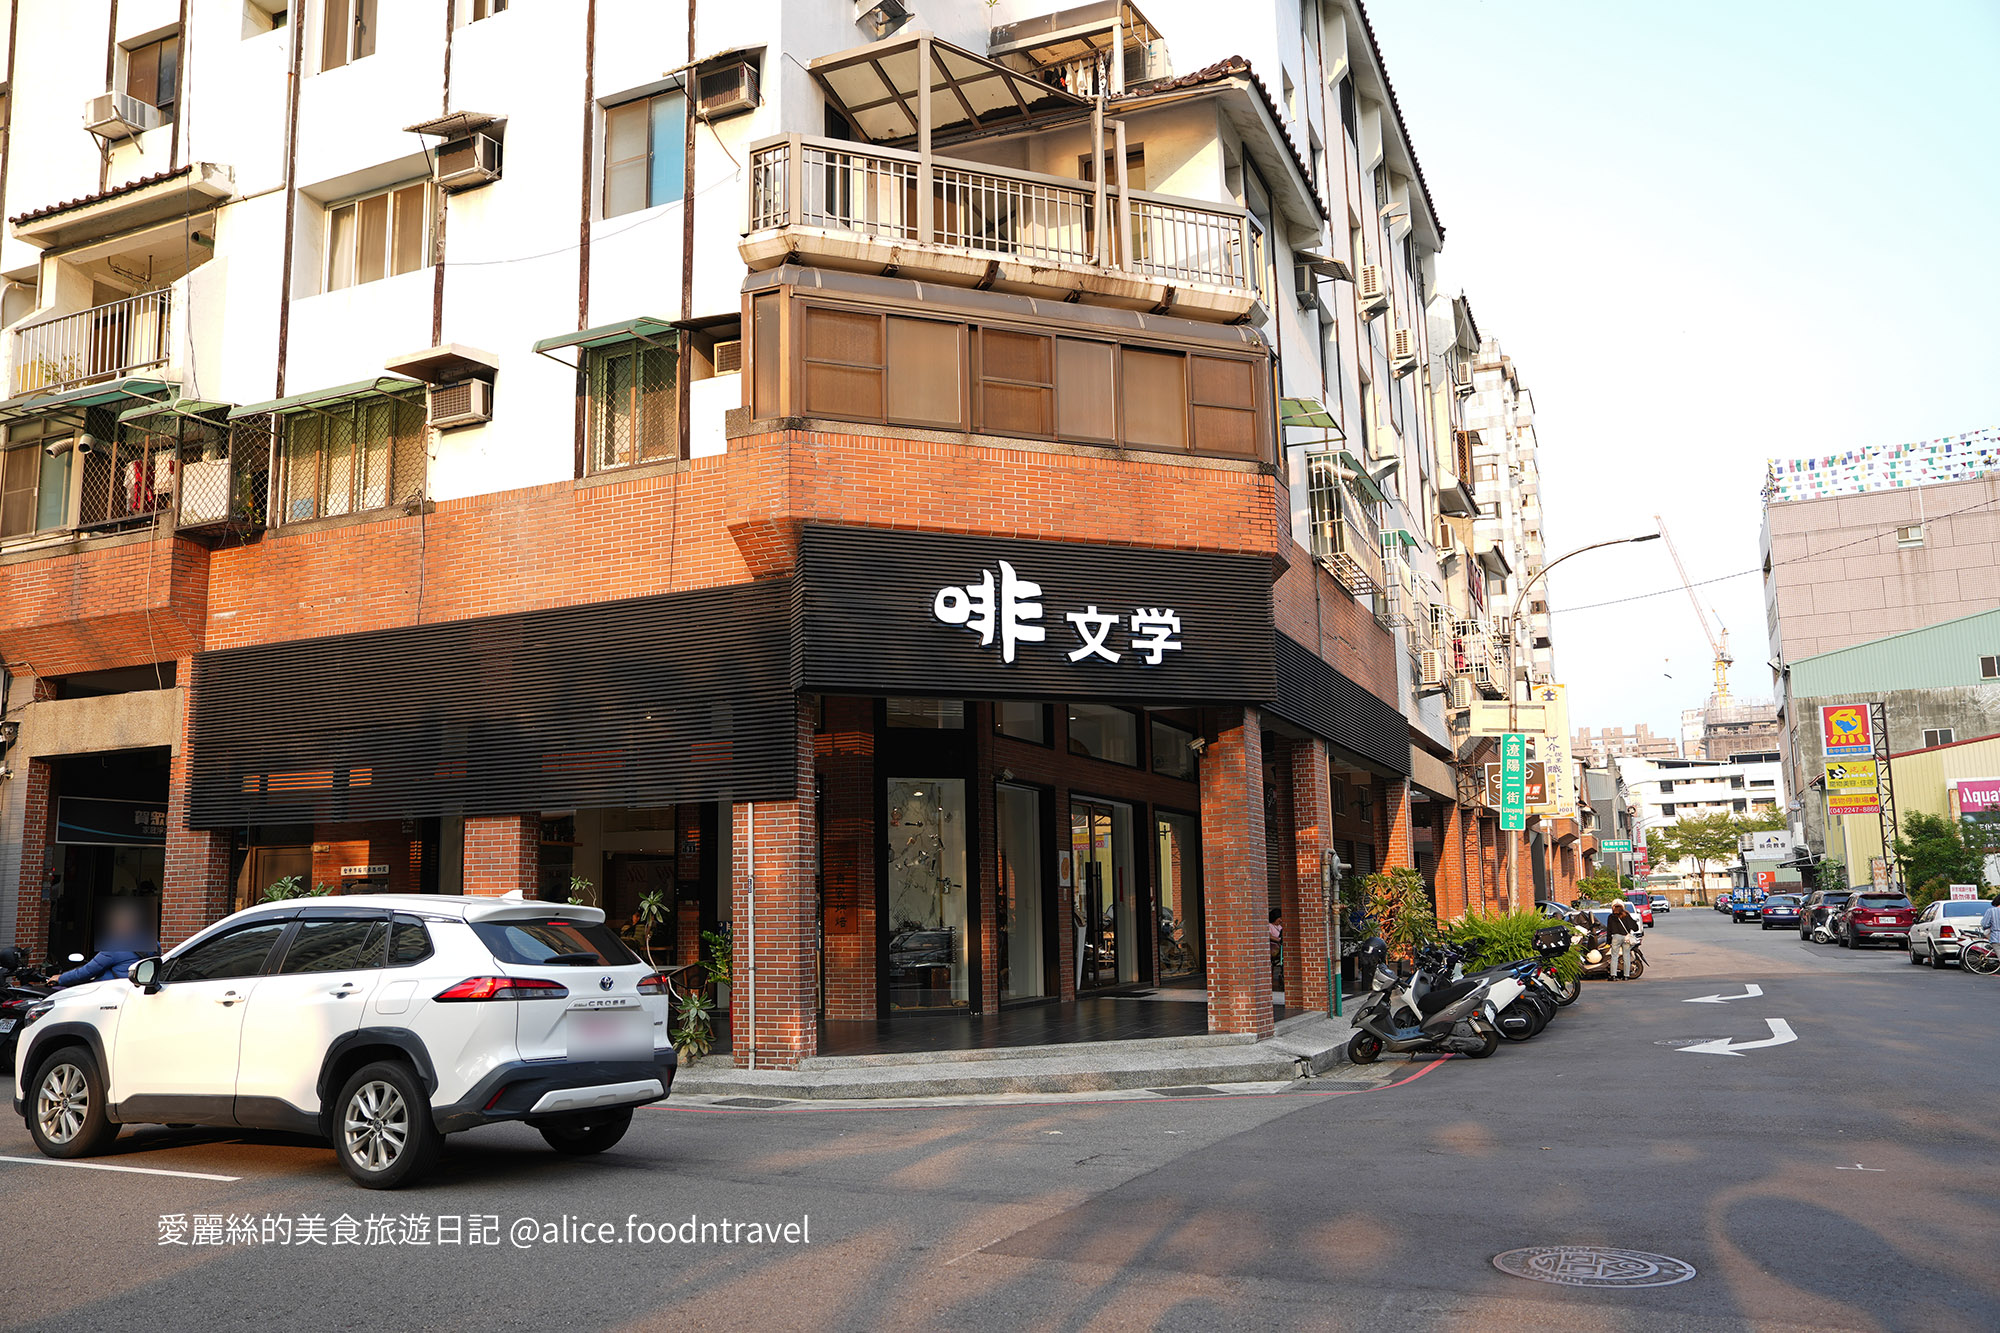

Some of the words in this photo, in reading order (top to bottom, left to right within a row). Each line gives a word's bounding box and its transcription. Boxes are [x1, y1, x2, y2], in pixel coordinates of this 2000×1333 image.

[1506, 743, 1520, 805] 遼陽二街
[1962, 787, 2000, 806] Aqua
[1759, 873, 1767, 885] P
